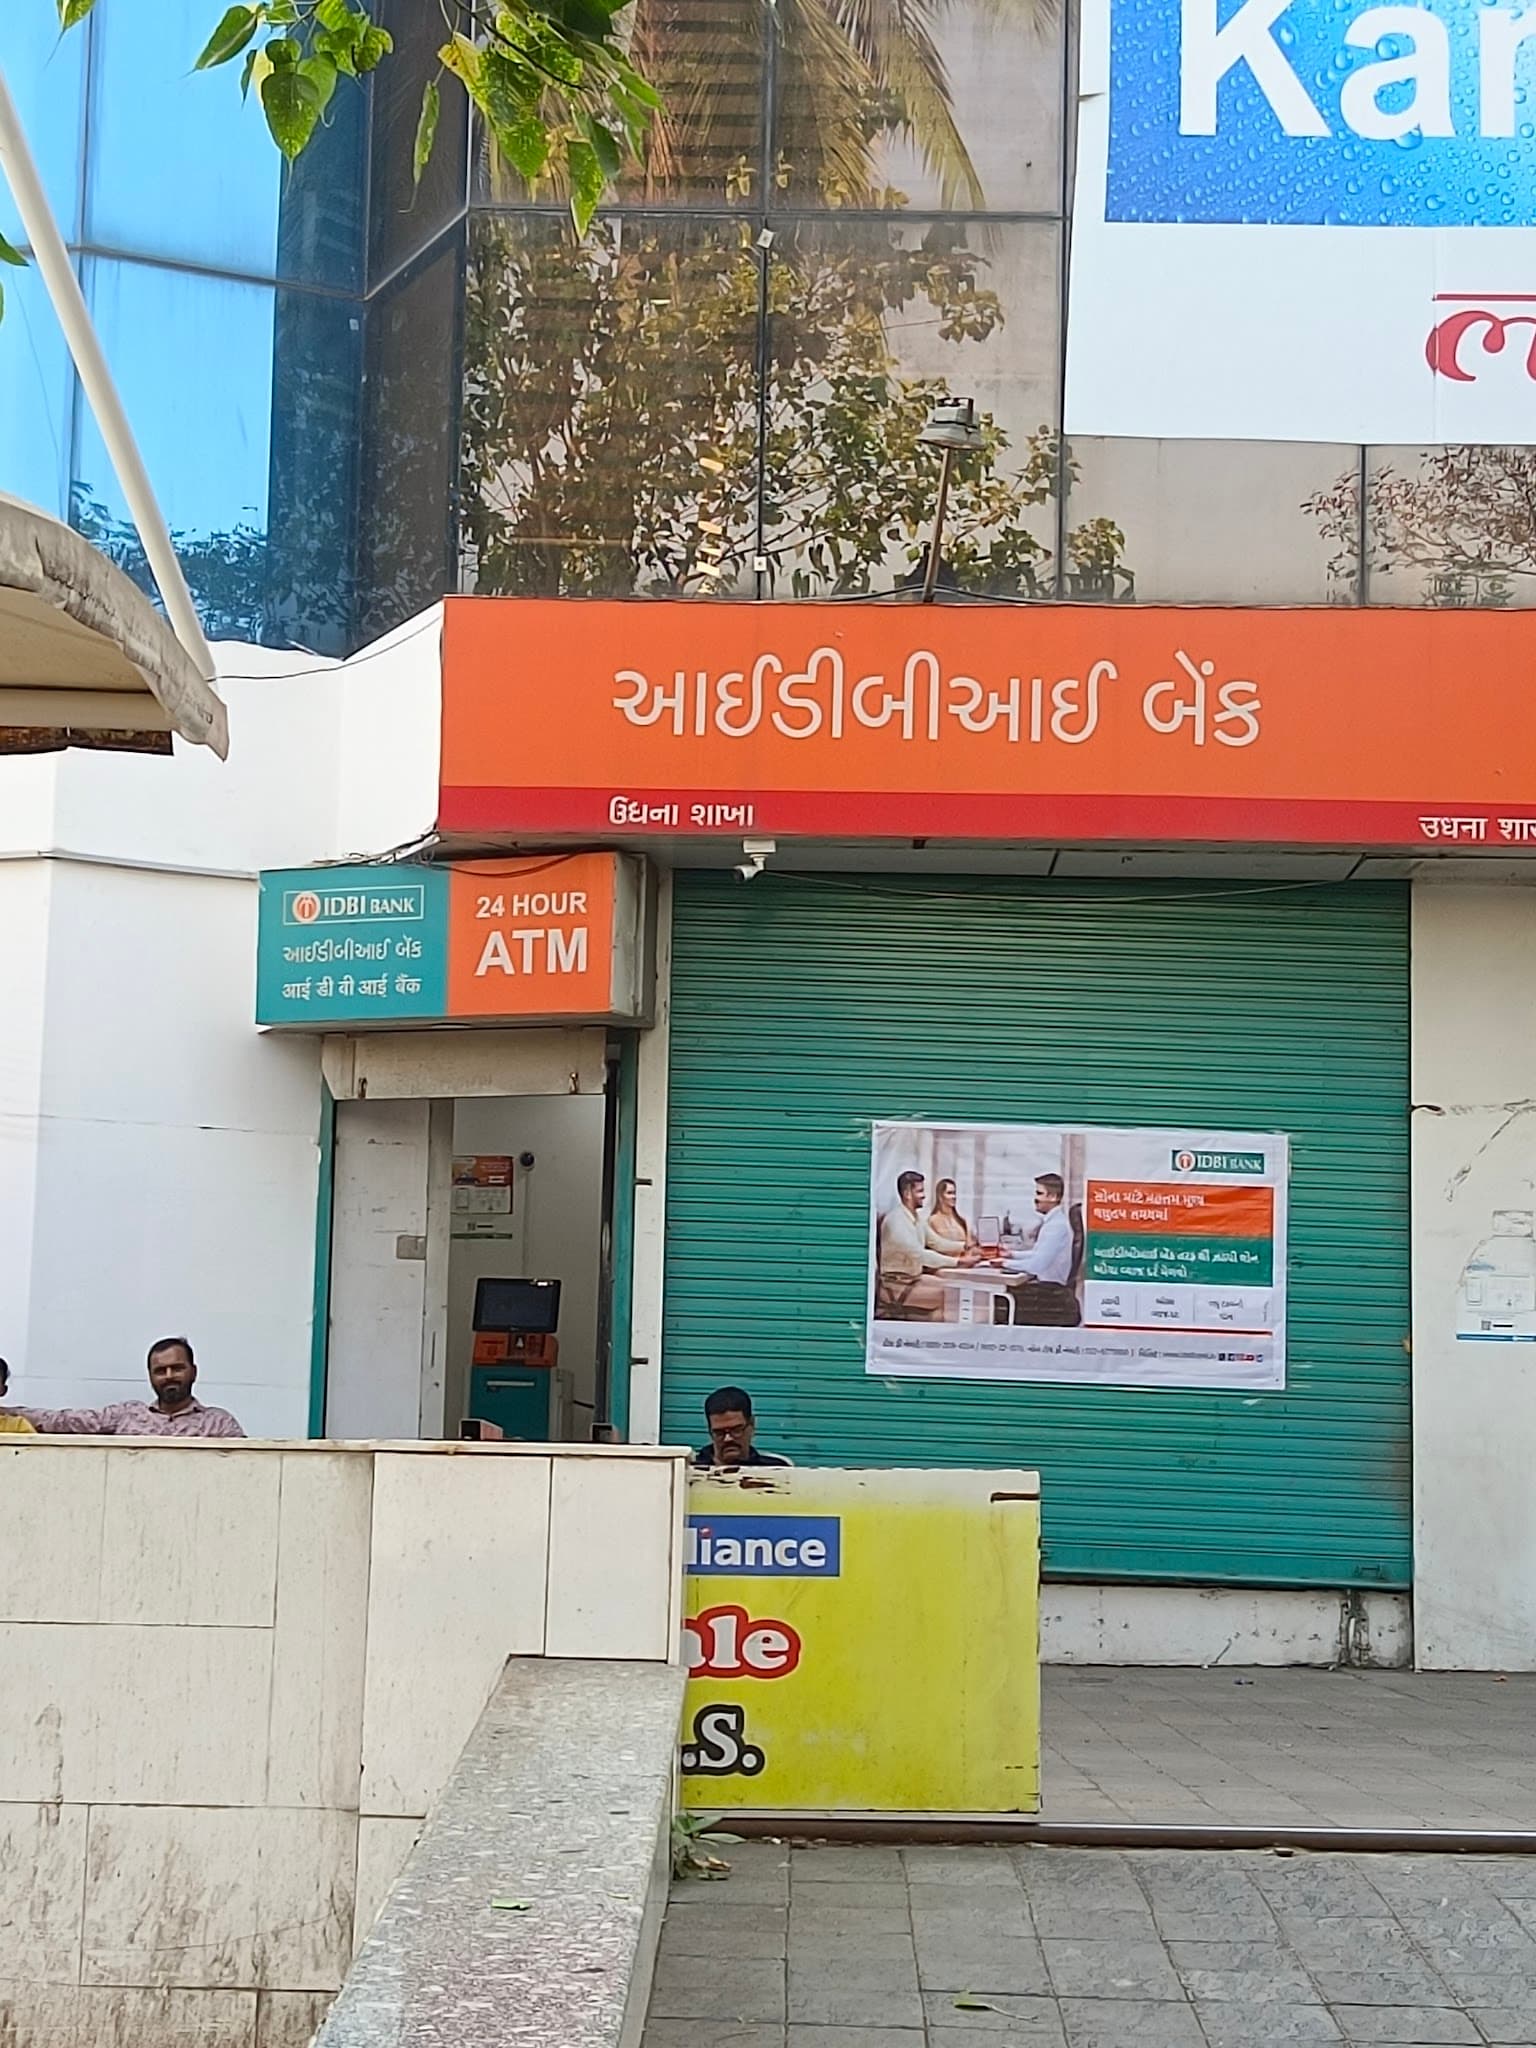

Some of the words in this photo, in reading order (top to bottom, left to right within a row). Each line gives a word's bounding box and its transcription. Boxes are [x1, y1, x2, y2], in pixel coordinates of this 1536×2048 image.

[613, 647, 1118, 742] આઈડીબીઆઈ
[1142, 649, 1261, 747] બેંક
[609, 795, 679, 827] ઉધના
[690, 804, 754, 827] શાખા
[1418, 816, 1489, 840] उधना
[1497, 818, 1536, 841] शा
[323, 895, 366, 916] IDBI
[370, 897, 415, 915] BANK
[474, 894, 506, 919] 24
[512, 891, 588, 917] HOUR
[282, 937, 391, 963] આઈડીબીઆઈ
[474, 927, 589, 977] ATM
[282, 976, 312, 1001] आई
[316, 975, 334, 997] डी
[358, 972, 388, 998] आई
[1196, 1153, 1227, 1169] IDBI
[1229, 1156, 1262, 1171] BANK
